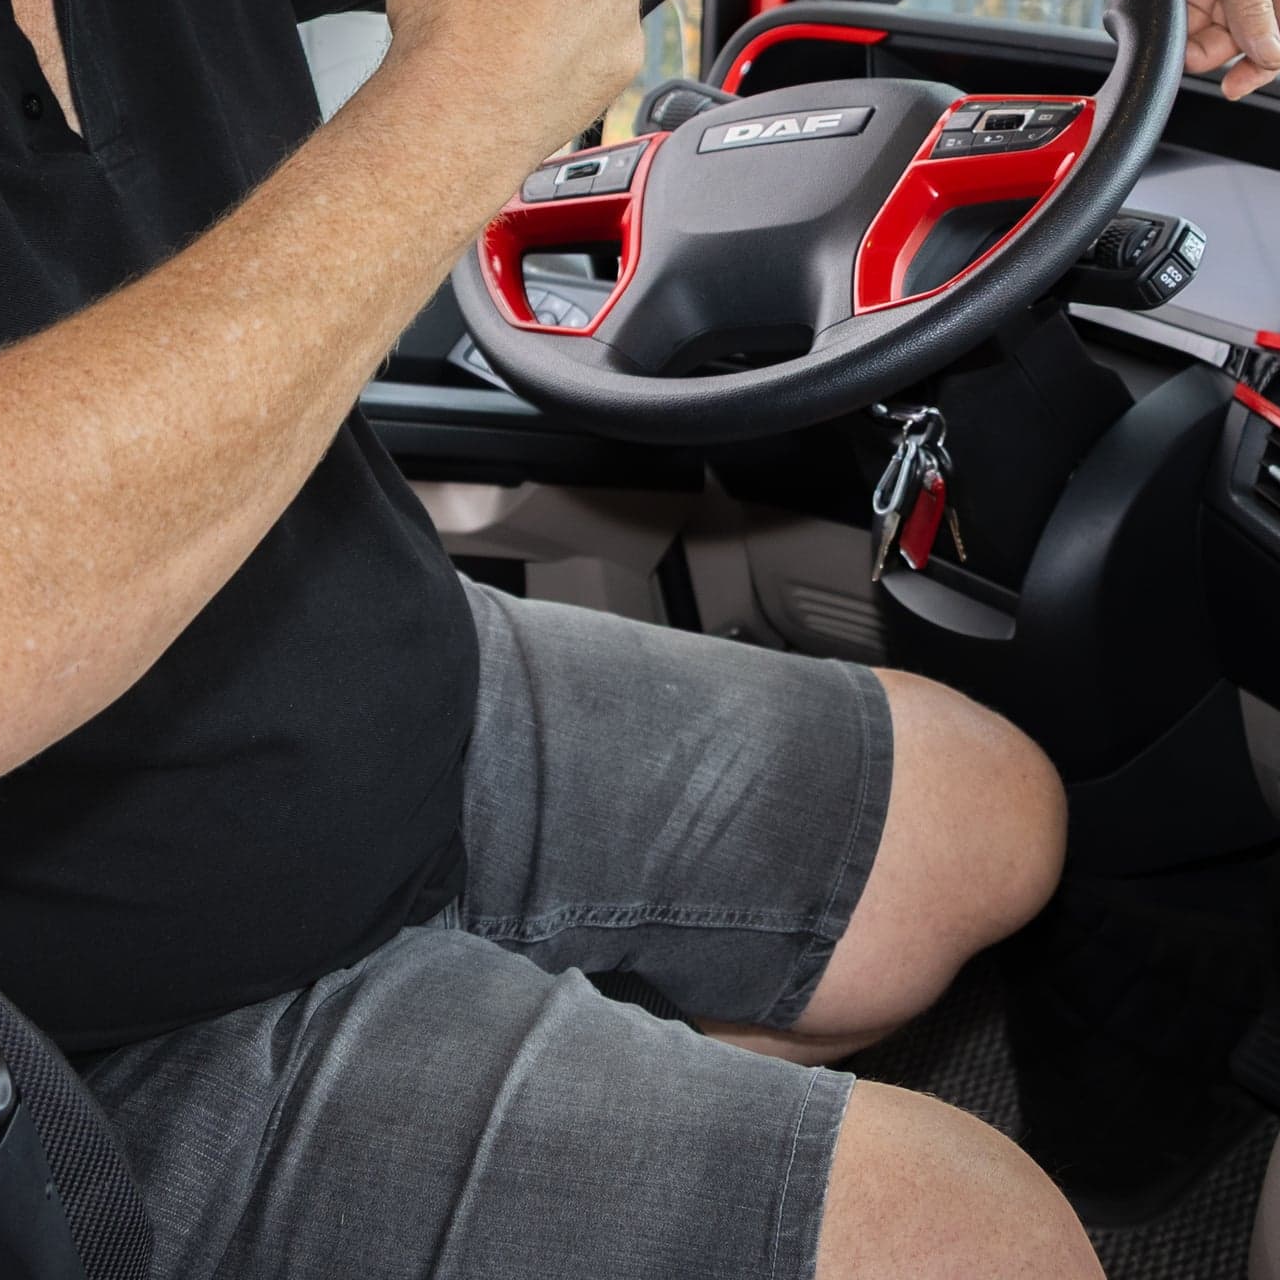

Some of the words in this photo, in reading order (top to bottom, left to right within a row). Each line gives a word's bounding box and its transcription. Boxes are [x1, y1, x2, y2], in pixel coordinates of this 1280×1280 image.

[722, 113, 843, 144] DAF
[1160, 272, 1177, 289] OFF
[1166, 265, 1183, 282] ECO
